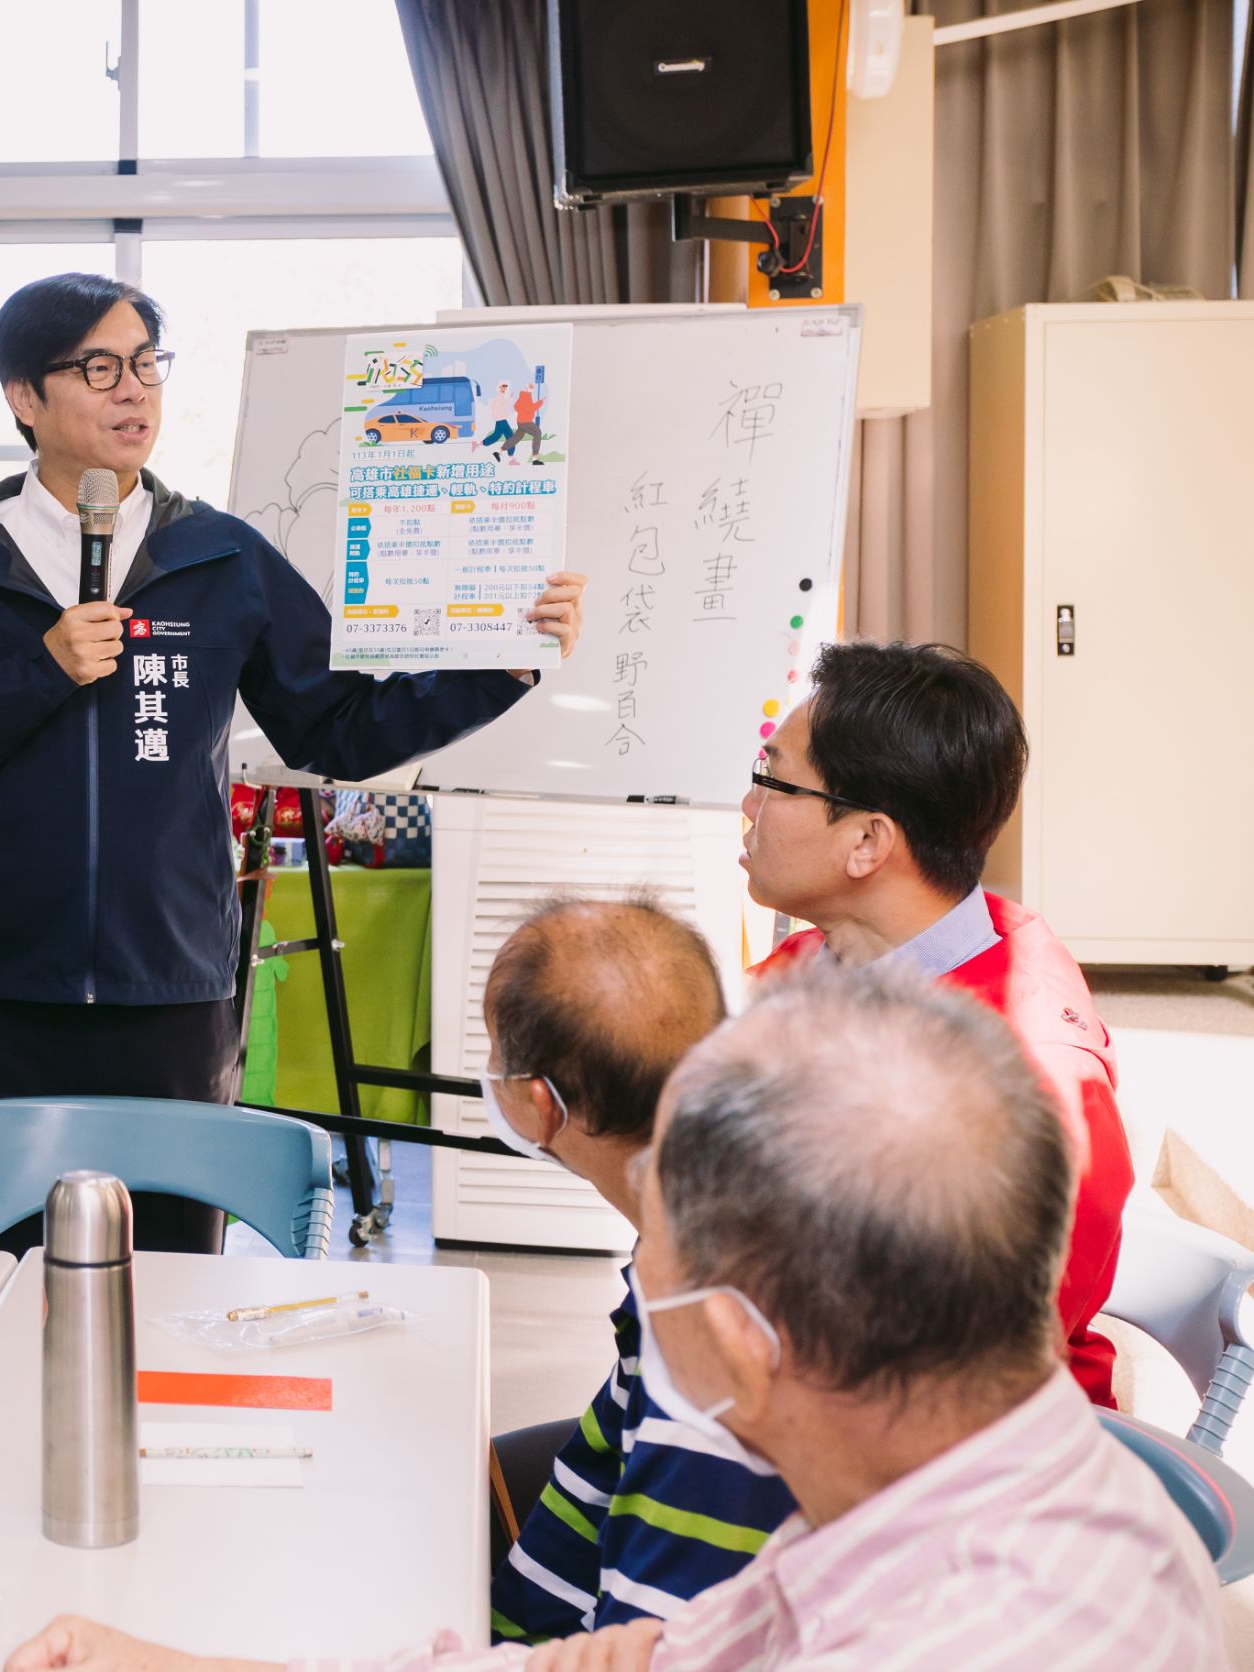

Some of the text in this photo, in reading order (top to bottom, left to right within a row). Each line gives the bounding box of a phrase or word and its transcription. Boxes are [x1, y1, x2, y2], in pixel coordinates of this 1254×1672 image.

[350, 463, 496, 482] 高雄市社福卡新增用途
[346, 623, 407, 633] 07-3373376
[450, 622, 513, 632] 07-3308447
[171, 653, 189, 688] 市長
[133, 653, 170, 762] 陳其邁
